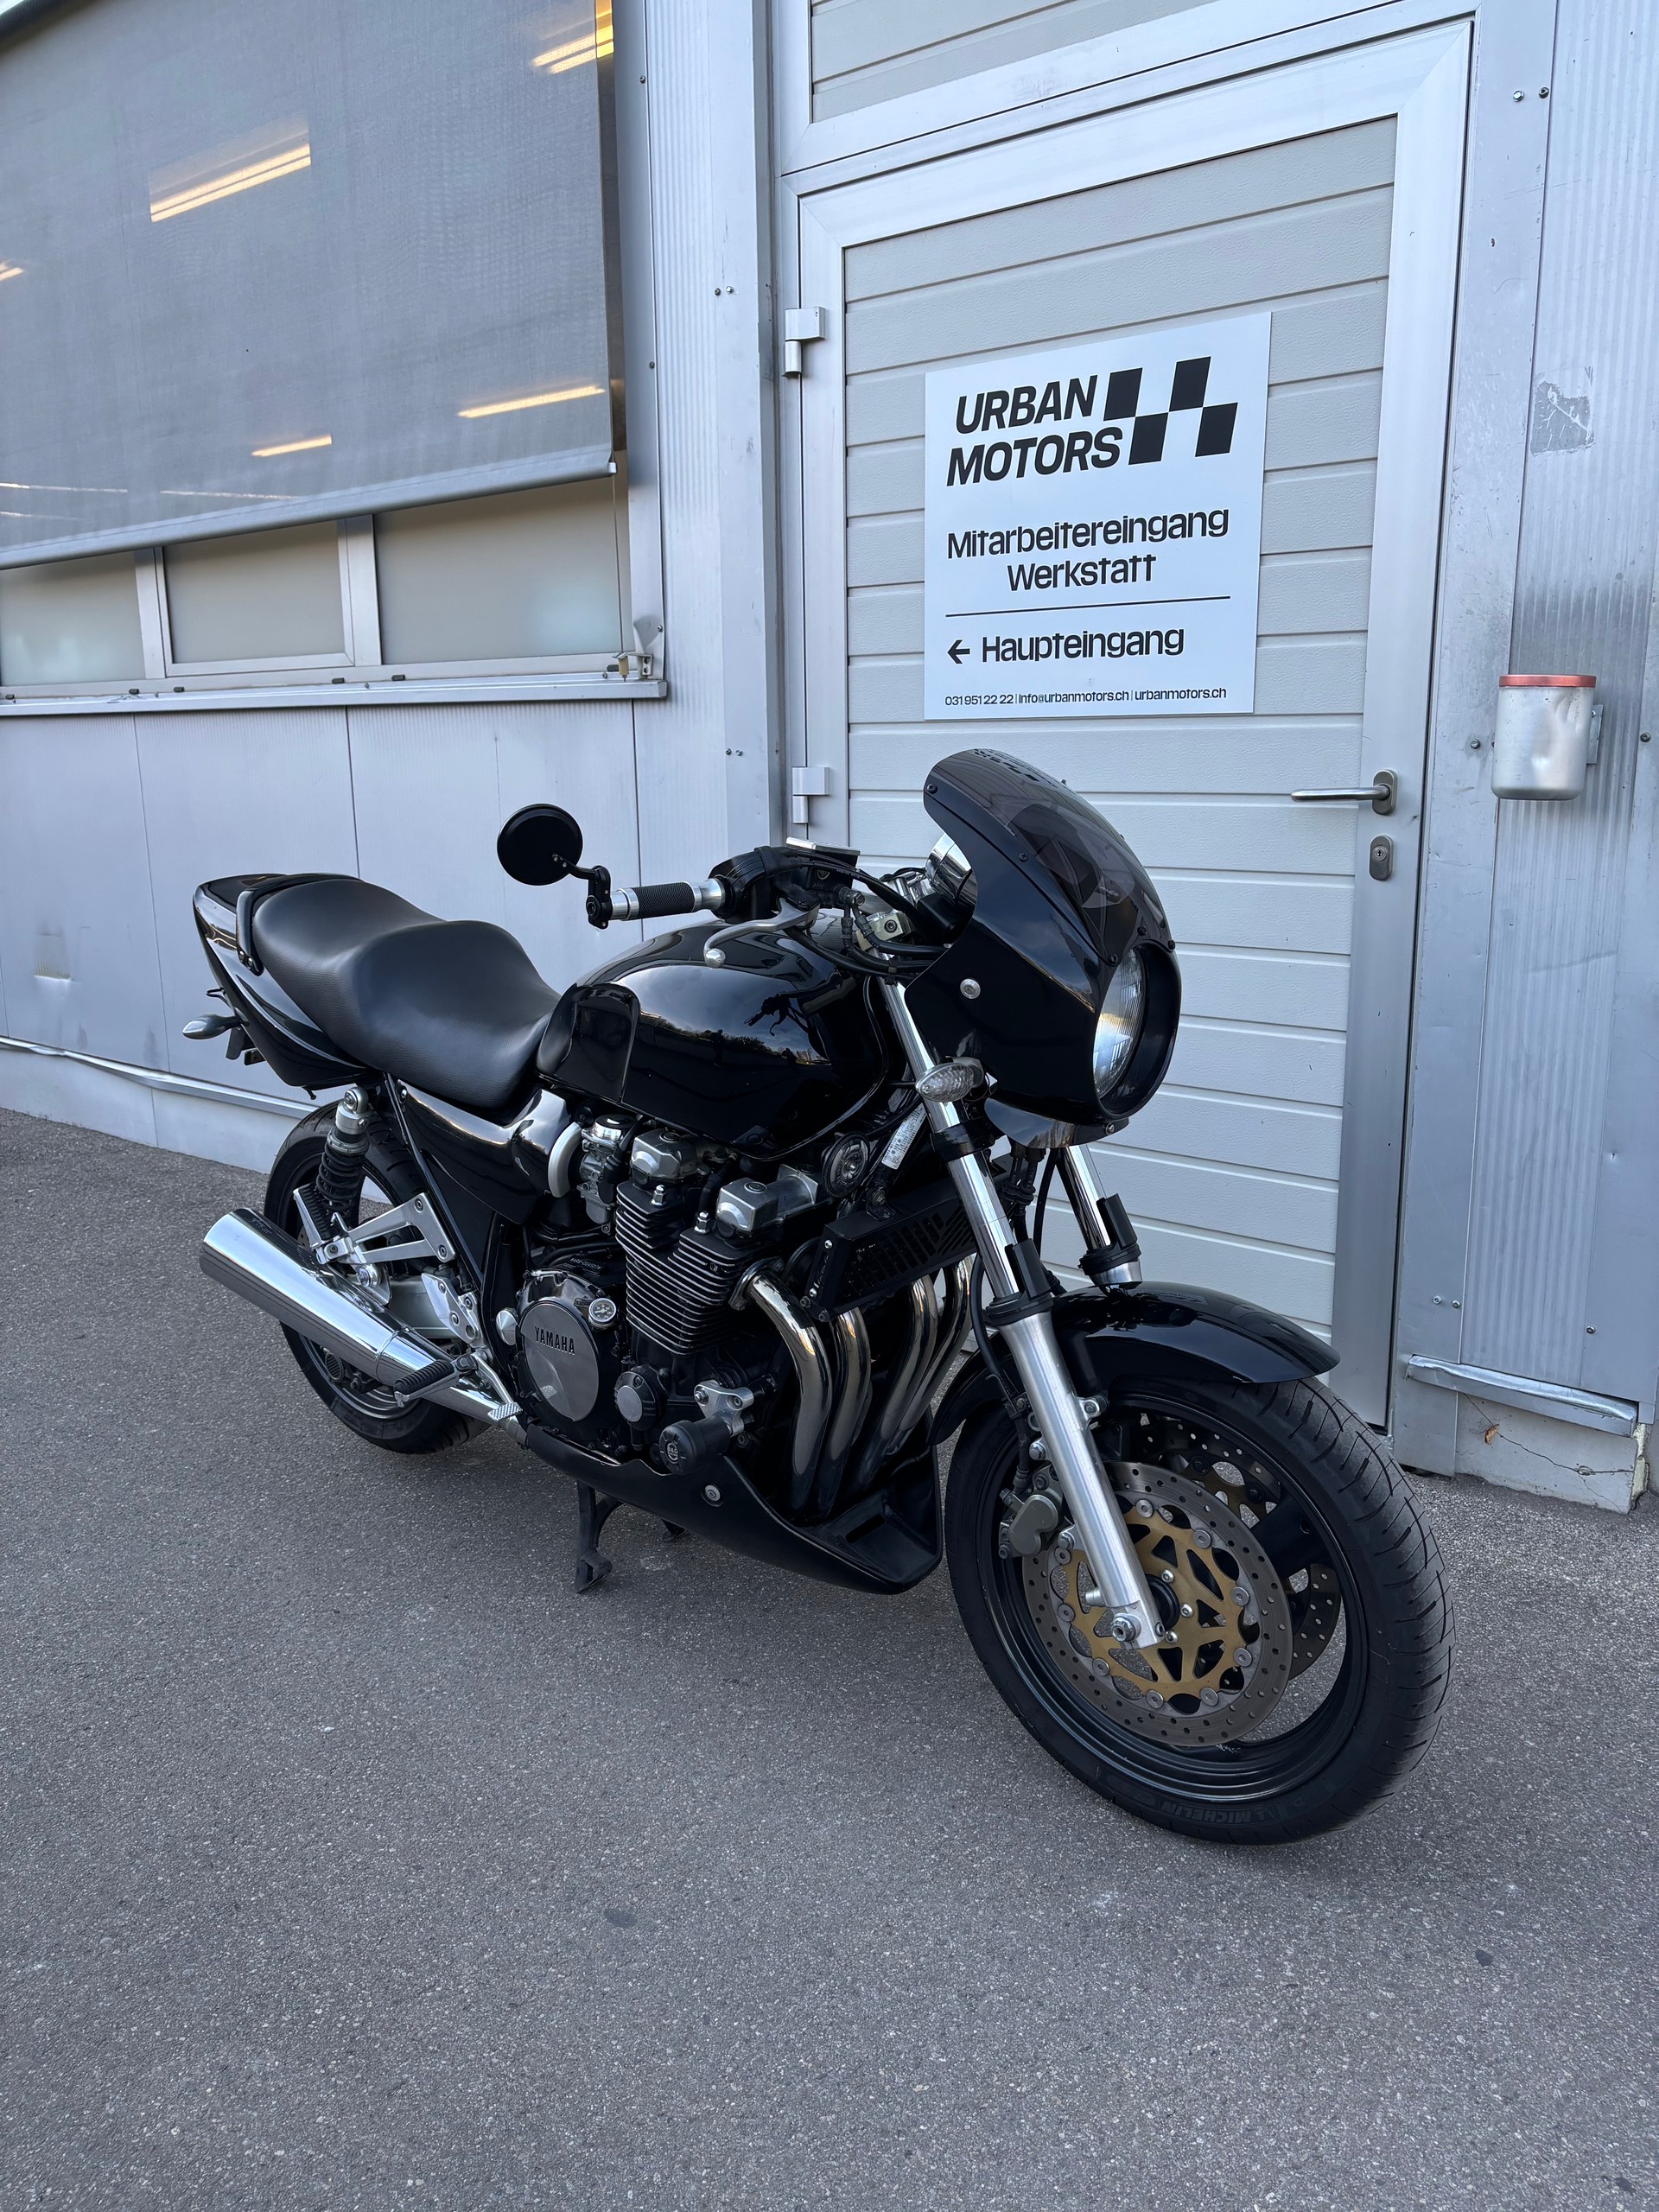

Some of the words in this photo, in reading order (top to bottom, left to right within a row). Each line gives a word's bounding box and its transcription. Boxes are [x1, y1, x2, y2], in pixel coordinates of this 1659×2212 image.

[956, 374, 1098, 435] URBAN
[946, 426, 1123, 487] MOTORS
[948, 509, 1229, 558] Mitarbeitereingang
[1007, 553, 1157, 592] Werkstatt
[982, 627, 1185, 663] Haupteingang
[983, 695, 998, 705] 22
[999, 694, 1014, 704] 22
[1135, 687, 1228, 701] urbanmotors.ch
[534, 1326, 575, 1356] YAMAHA
[1161, 1802, 1251, 1823] MICHELIN
